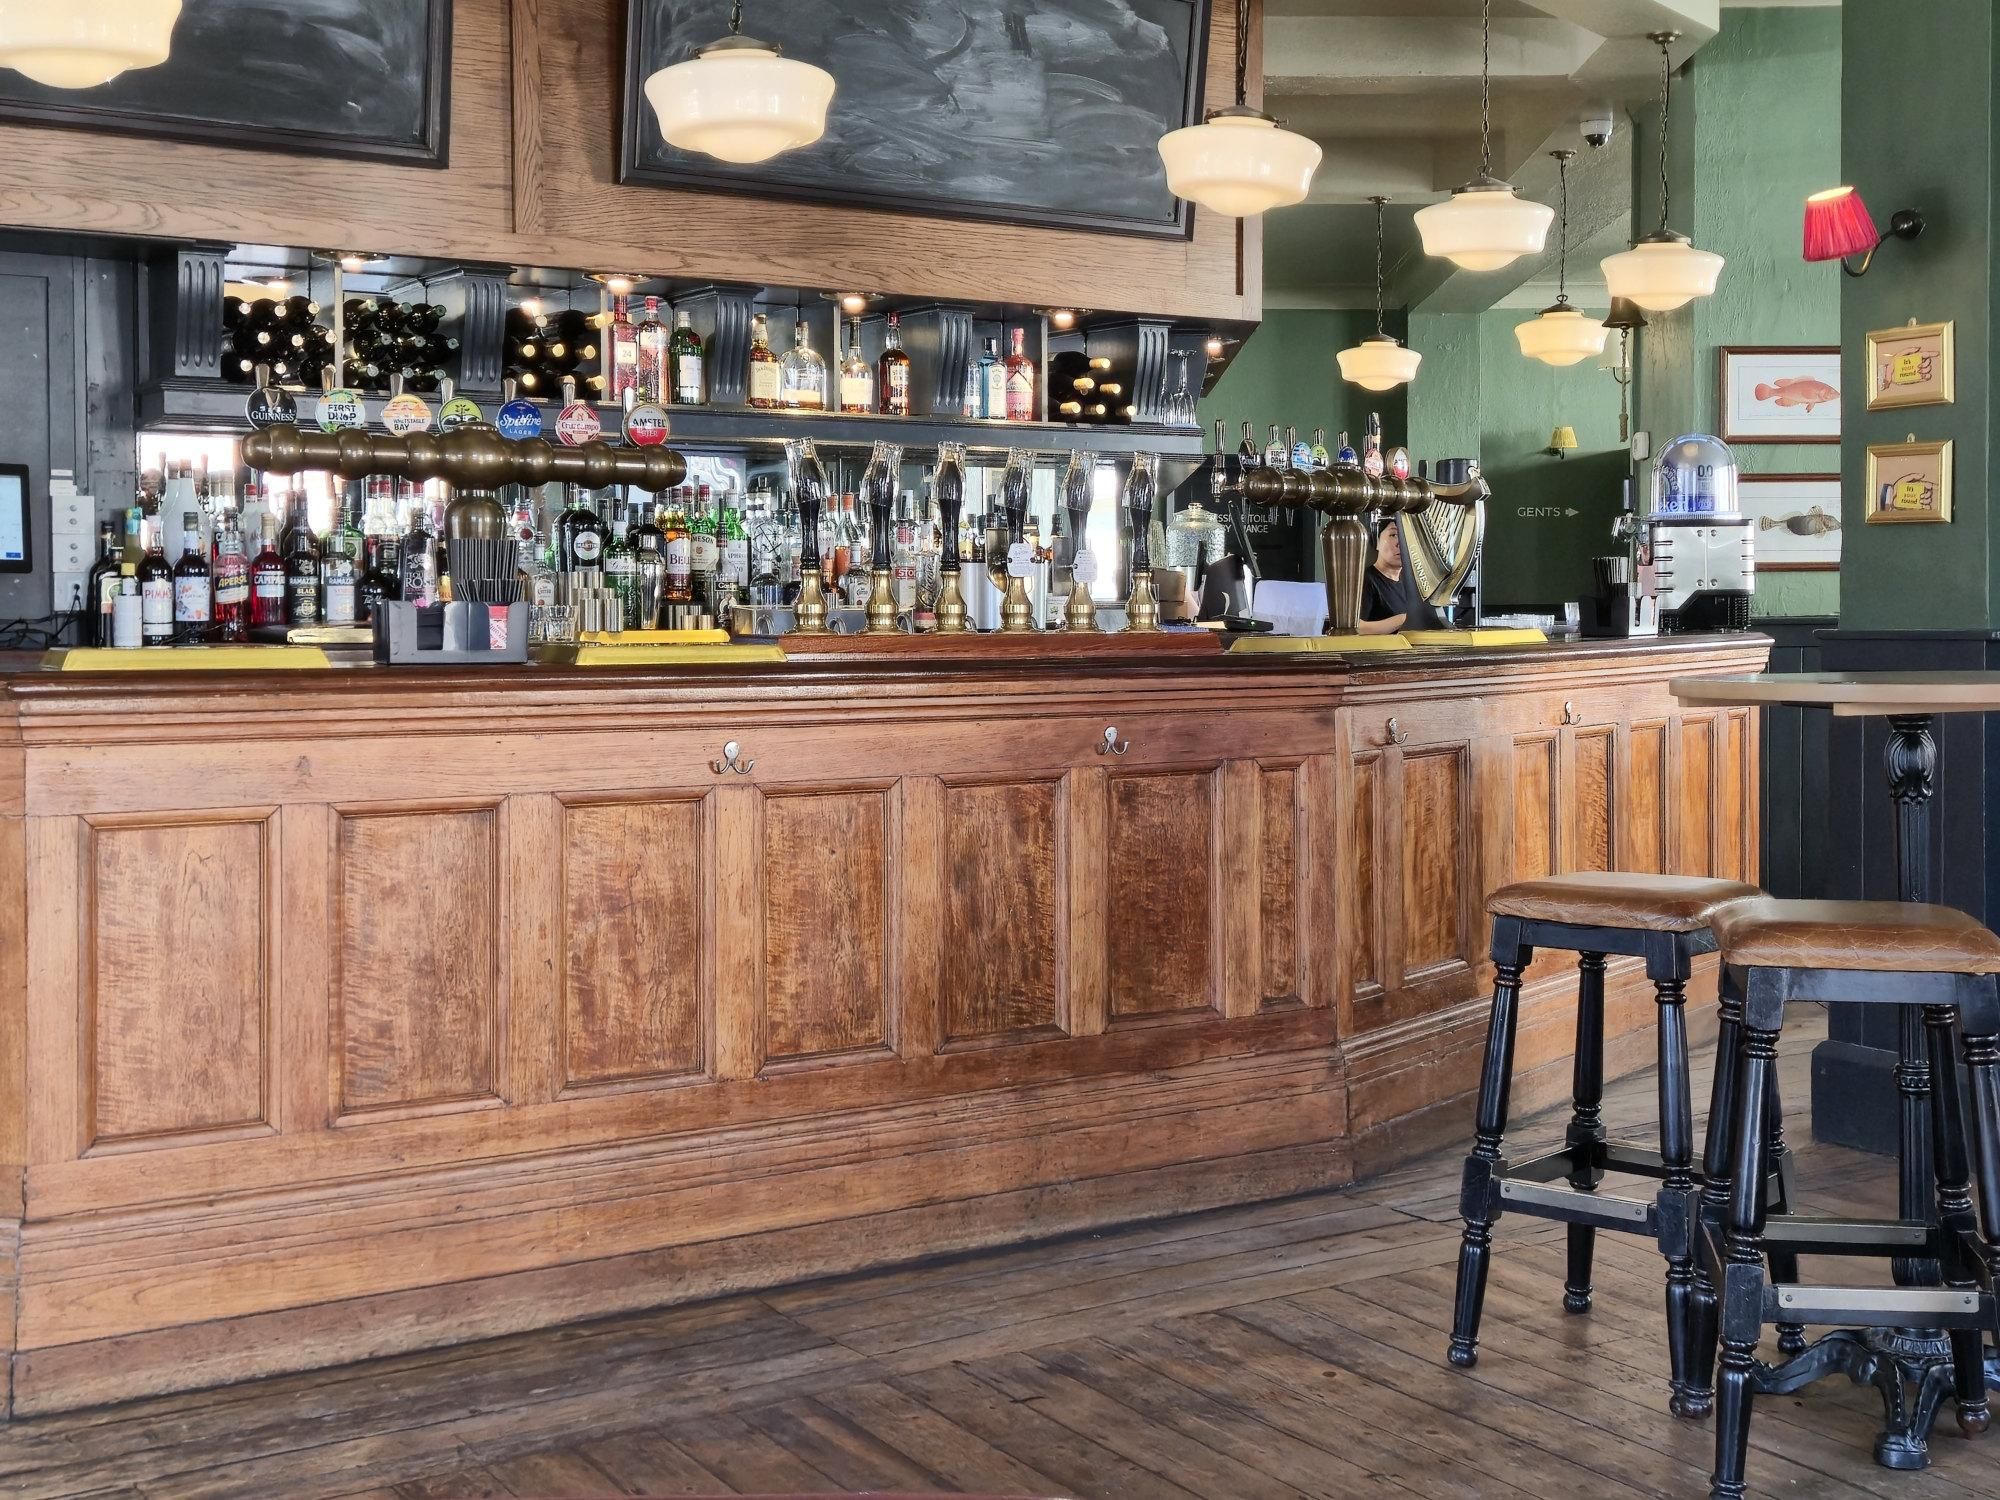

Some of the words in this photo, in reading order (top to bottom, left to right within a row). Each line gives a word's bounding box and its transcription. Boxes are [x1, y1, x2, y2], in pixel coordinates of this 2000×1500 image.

[328, 404, 356, 412] FIRST
[251, 410, 295, 421] GUINNESS
[500, 414, 541, 429] Spitfire
[632, 418, 665, 428] AMSTEL
[1517, 507, 1561, 517] GENTS
